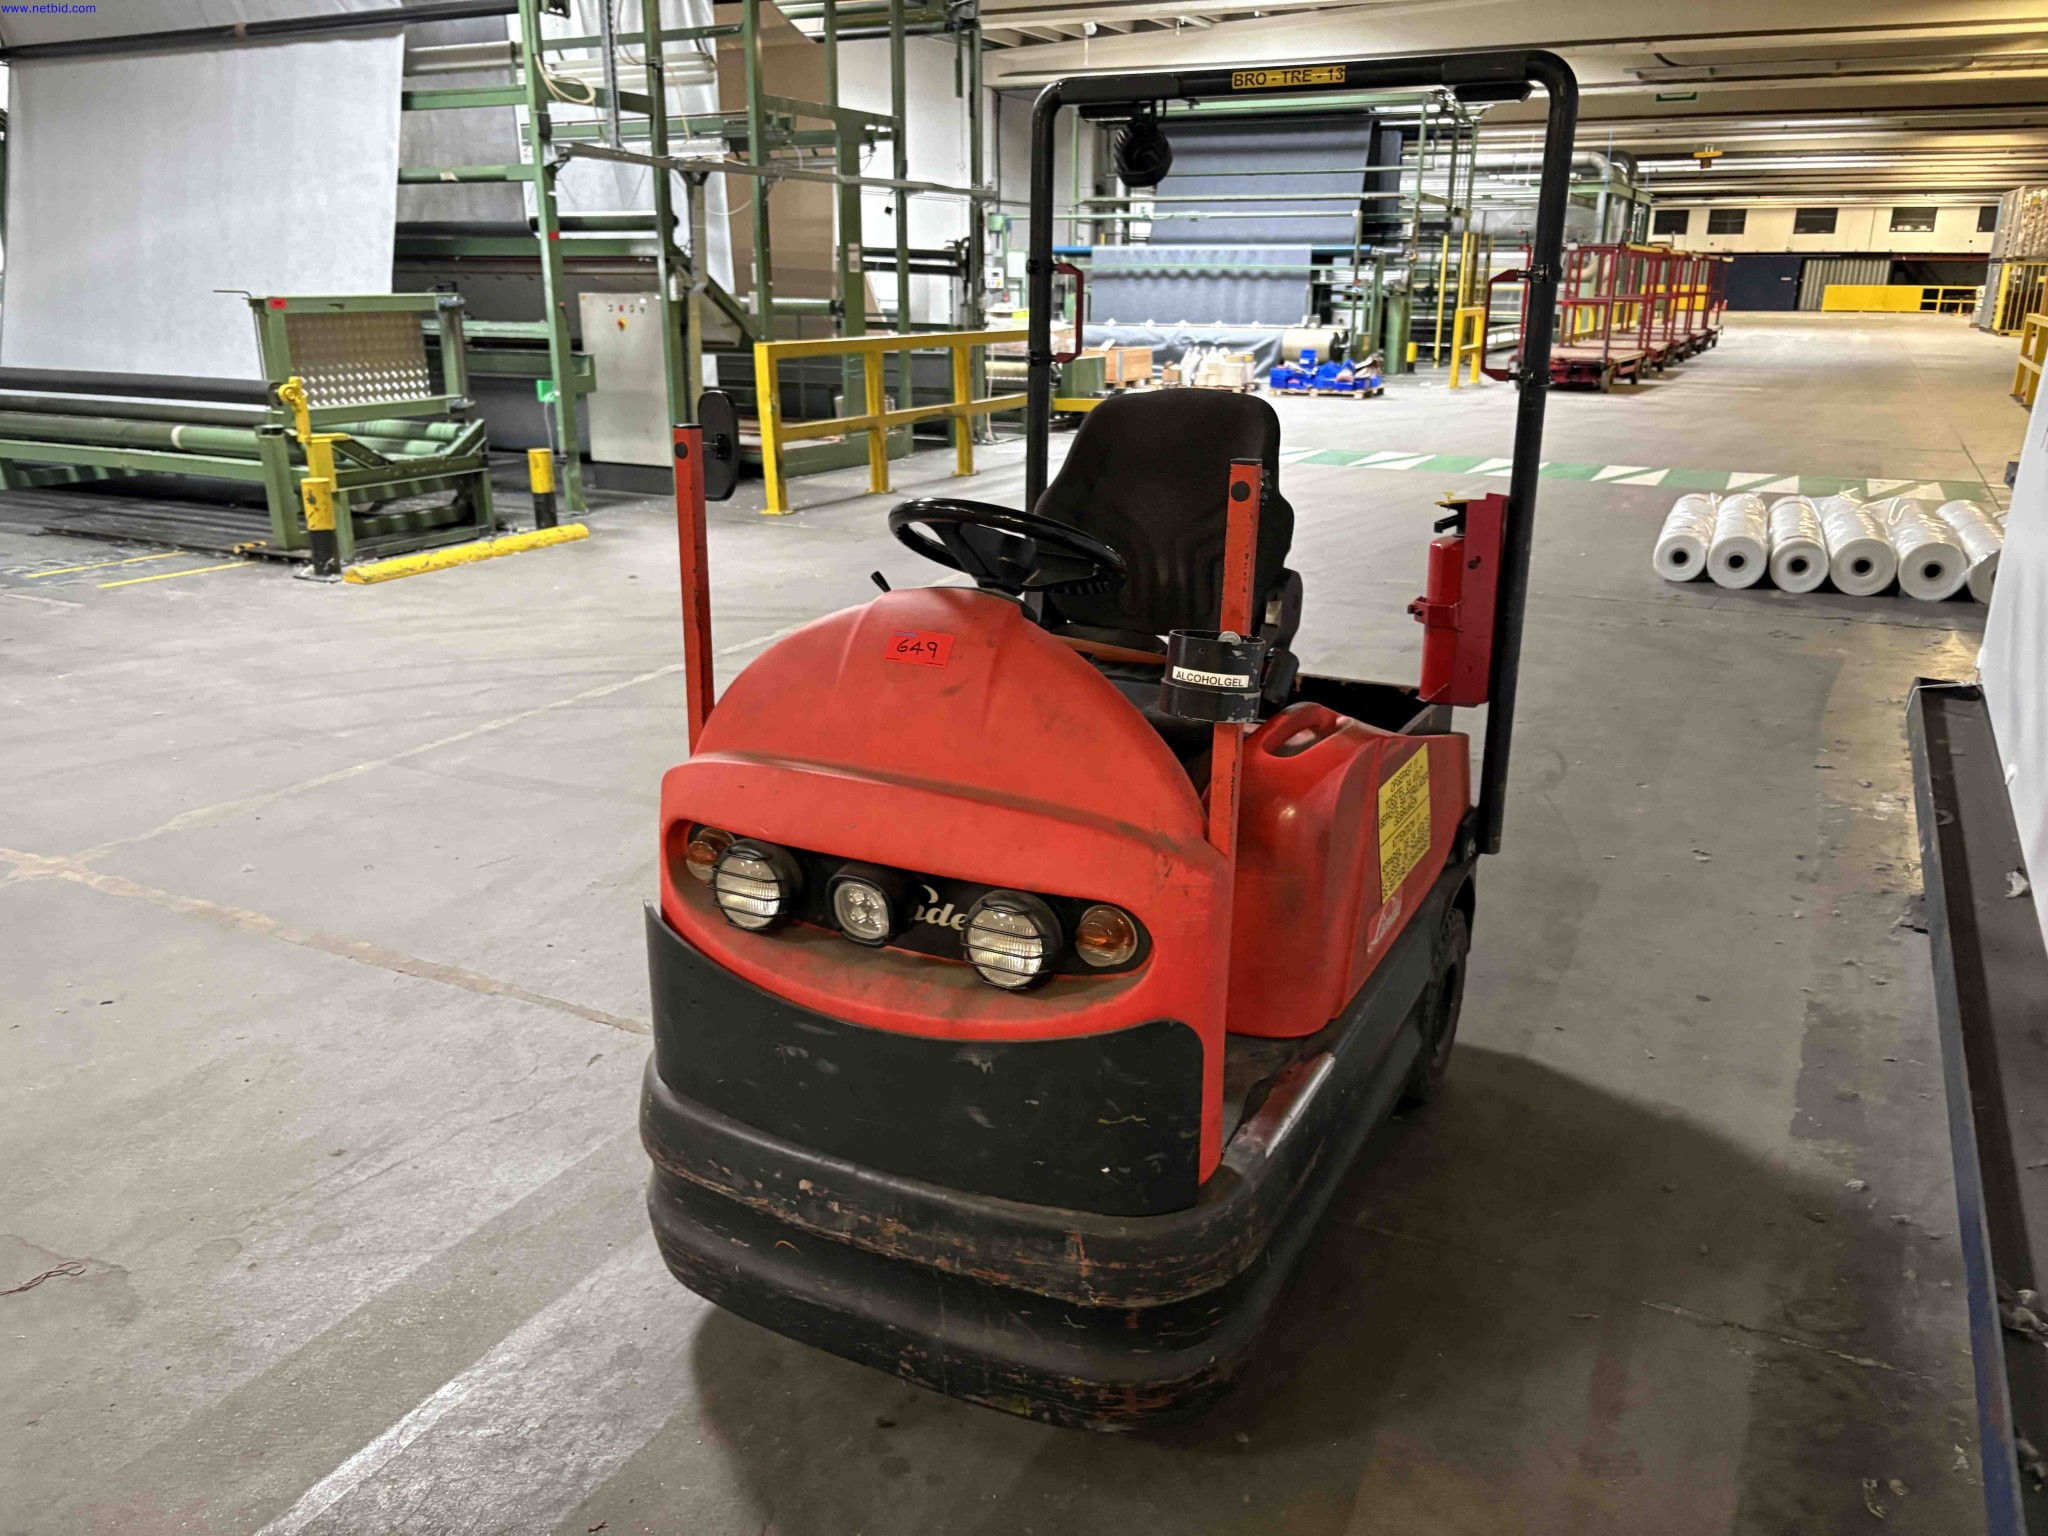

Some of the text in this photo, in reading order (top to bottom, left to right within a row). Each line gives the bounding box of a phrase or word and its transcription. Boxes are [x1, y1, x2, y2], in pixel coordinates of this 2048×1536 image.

[1234, 73, 1267, 87] BRO
[1281, 70, 1312, 83] TRE
[1328, 67, 1344, 81] 13
[896, 639, 938, 658] 649
[1176, 671, 1244, 687] ALCOHOLGEL
